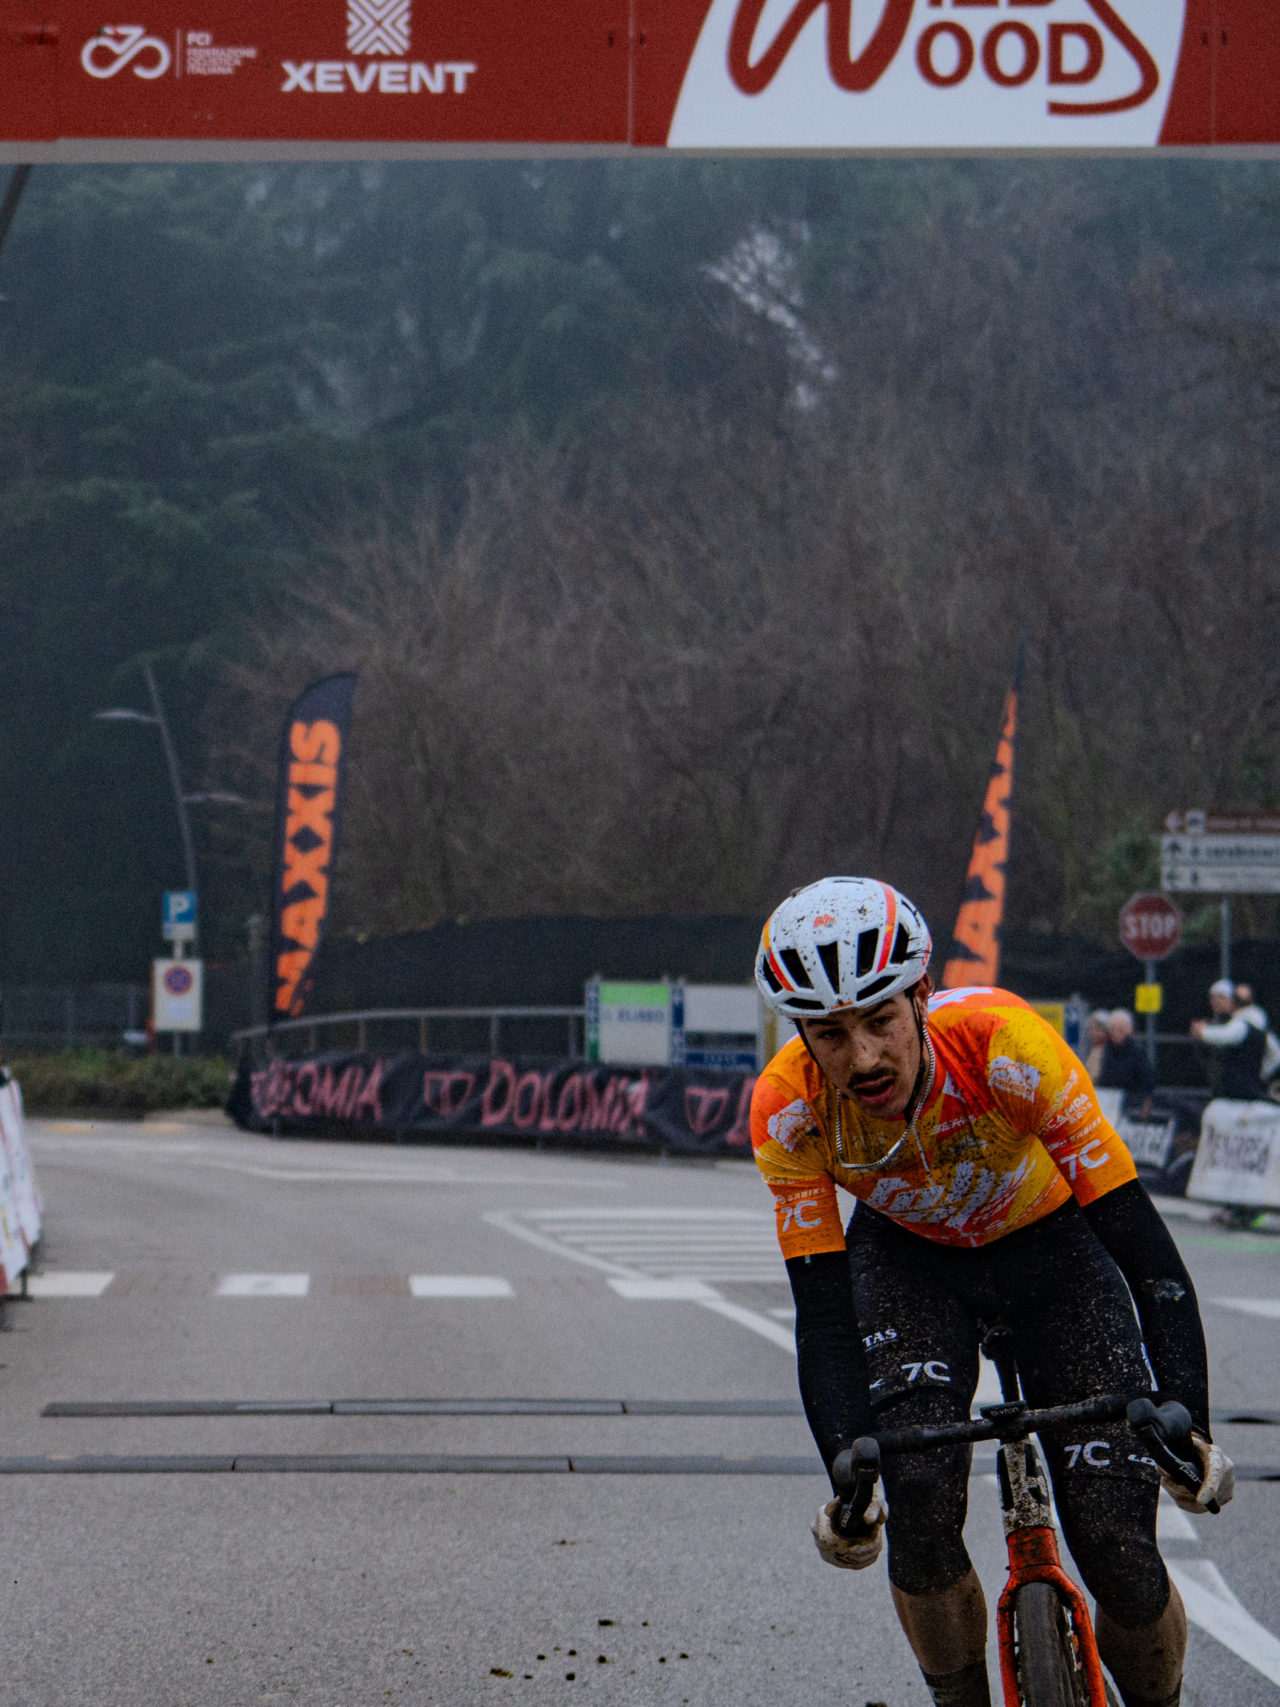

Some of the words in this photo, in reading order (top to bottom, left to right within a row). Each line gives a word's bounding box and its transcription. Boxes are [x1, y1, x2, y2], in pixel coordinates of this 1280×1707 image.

[281, 62, 476, 94] XEVENT
[169, 893, 190, 921] P
[1125, 914, 1176, 939] STOP
[1060, 1139, 1109, 1181] 7C
[780, 1200, 822, 1232] 7C
[901, 1361, 951, 1382] 7C
[1064, 1441, 1111, 1468] 7C
